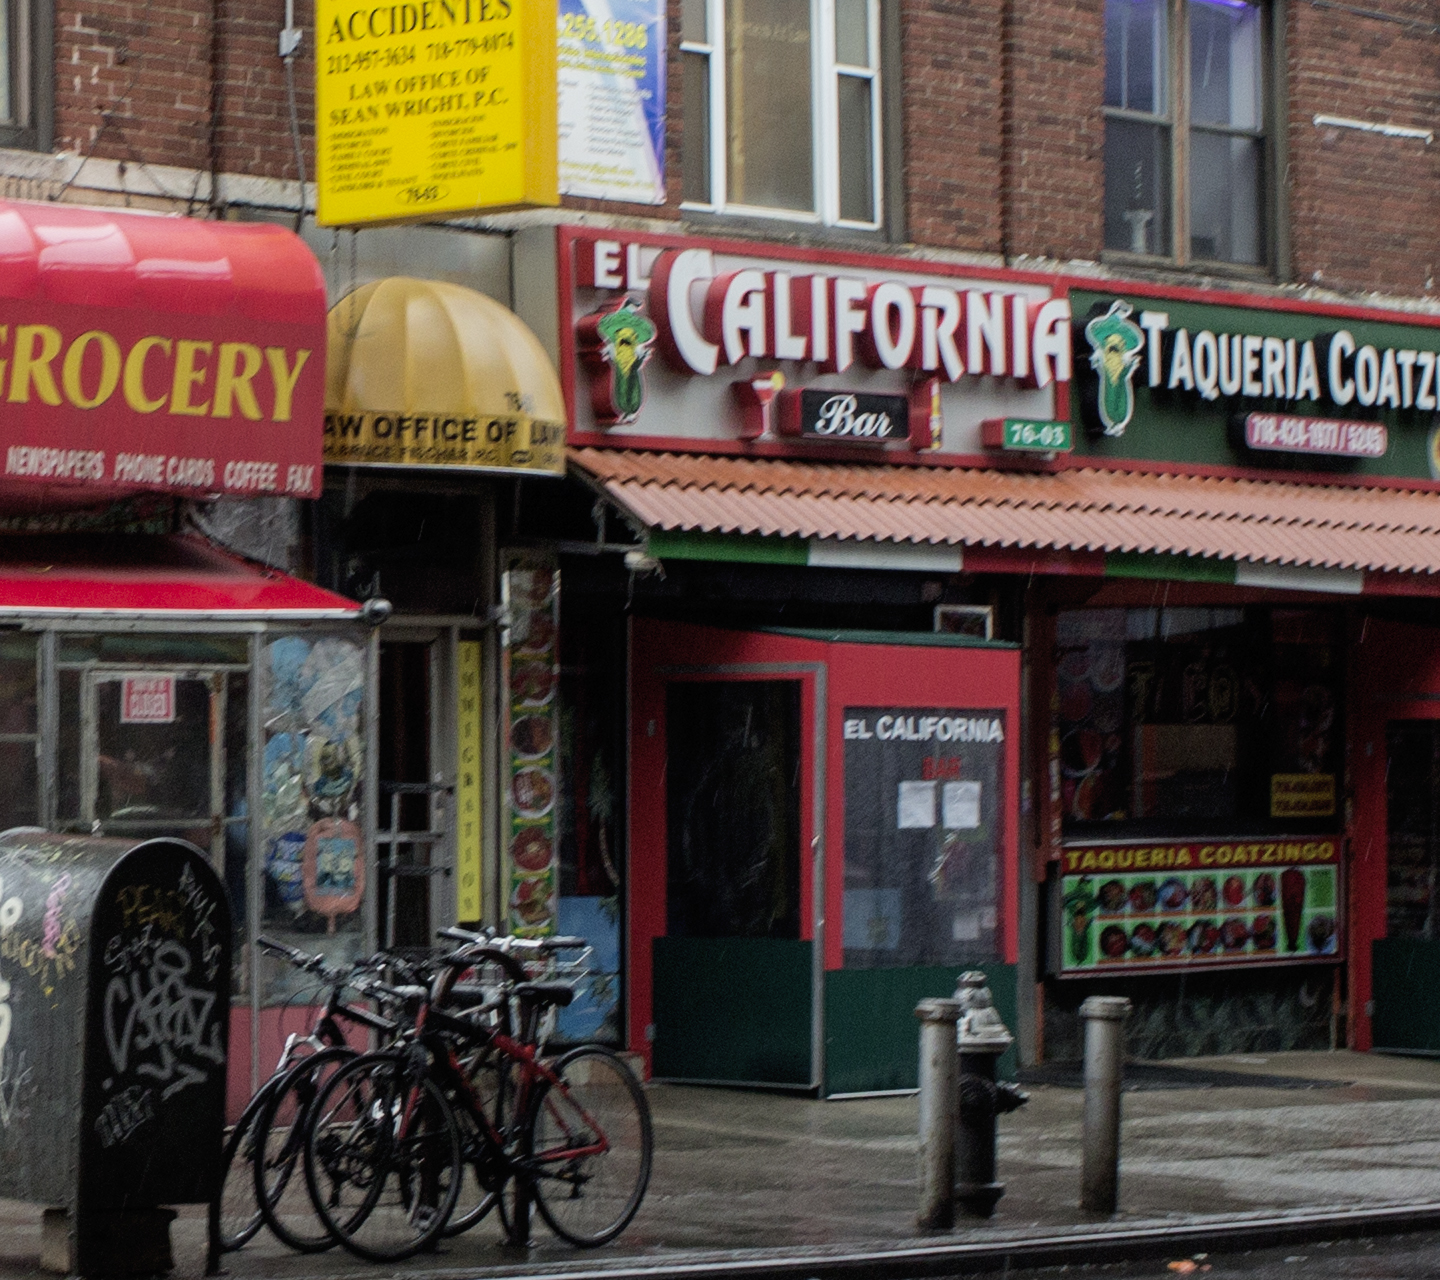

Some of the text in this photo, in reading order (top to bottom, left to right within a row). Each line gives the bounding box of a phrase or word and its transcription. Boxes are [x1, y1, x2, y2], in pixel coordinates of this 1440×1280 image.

[349, 65, 492, 101] LAW OFFICE OF
[329, 104, 380, 127] SEAN
[594, 240, 652, 290] EL
[667, 248, 1073, 390] CALIFORNIA
[1140, 310, 1321, 402] TAQUERIA
[375, 416, 478, 442] OFFICE
[488, 420, 518, 443] OF
[814, 394, 894, 438] Bar
[1009, 423, 1066, 447] 76-03
[6, 445, 105, 482] NEWSPAPERS
[114, 452, 164, 485] PHONE
[166, 457, 215, 488] CARDS
[224, 460, 278, 492] COFFEE
[286, 464, 315, 494] FAX
[844, 714, 1004, 744] EL CALIFORNIA
[1066, 841, 1336, 870] TAQUERIA COATZINGO
